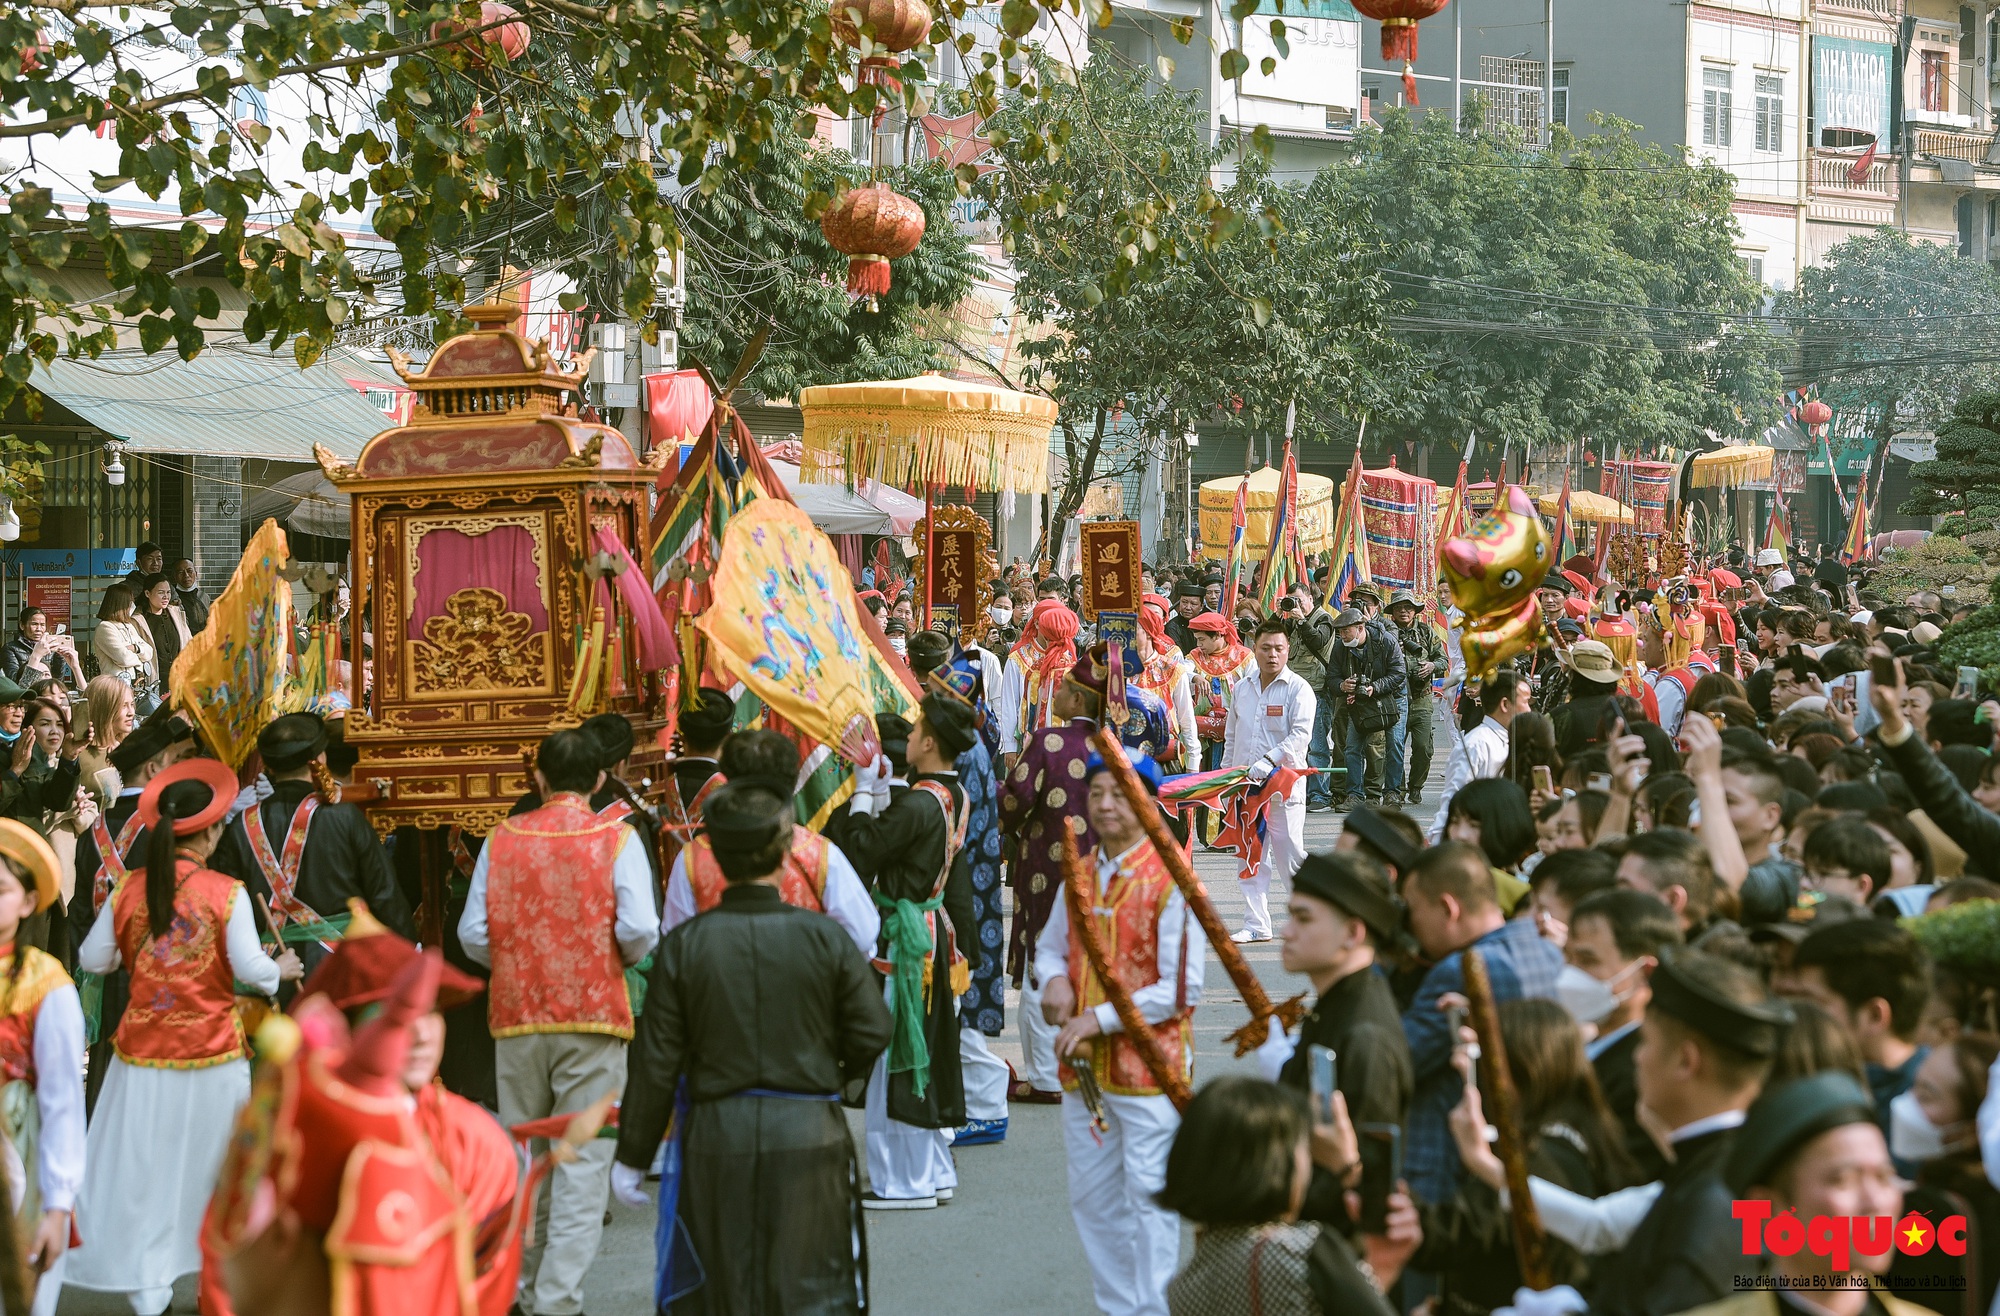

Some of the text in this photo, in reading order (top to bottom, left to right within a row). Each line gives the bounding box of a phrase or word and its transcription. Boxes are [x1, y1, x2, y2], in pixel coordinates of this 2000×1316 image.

[1820, 48, 1885, 84] NHA KHOA
[1846, 90, 1879, 124] CHÂU
